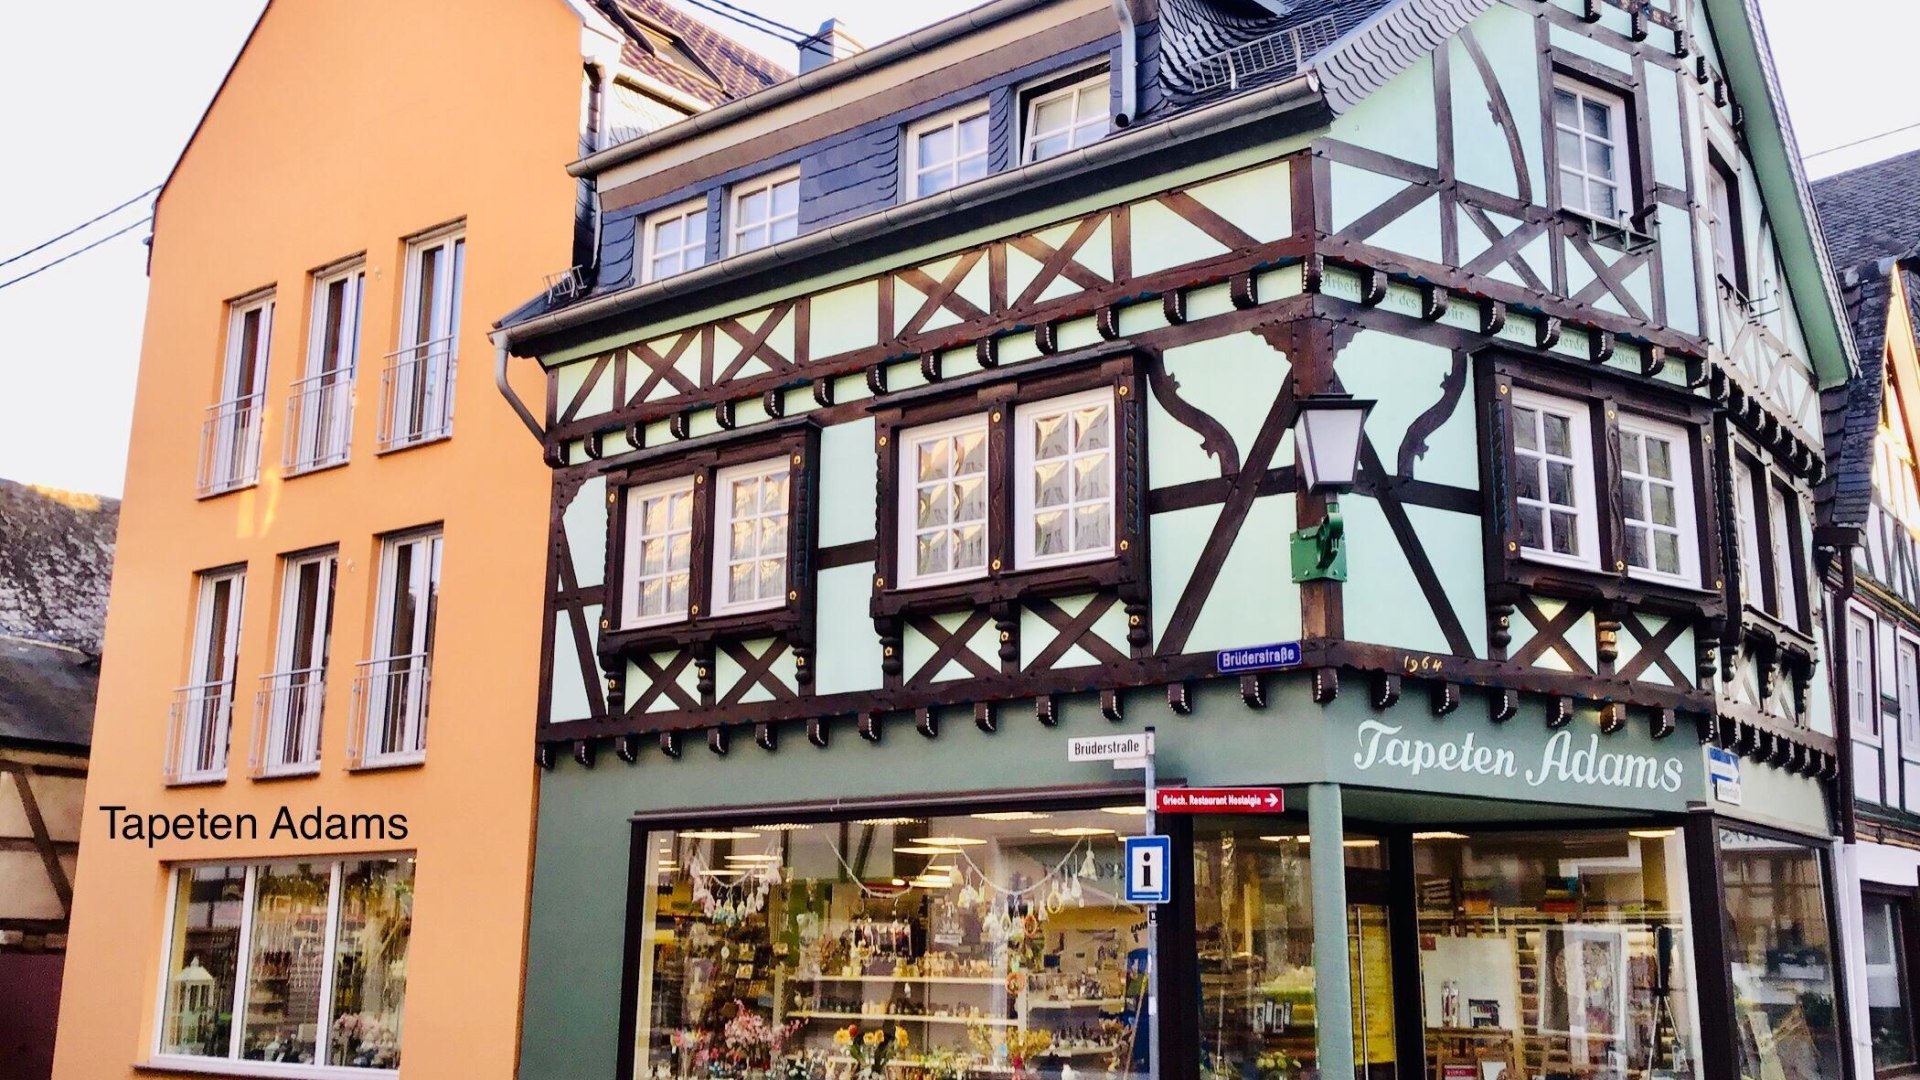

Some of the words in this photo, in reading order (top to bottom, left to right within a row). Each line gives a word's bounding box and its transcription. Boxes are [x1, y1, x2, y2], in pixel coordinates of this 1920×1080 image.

[1399, 294, 1418, 310] des
[1560, 335, 1587, 353] ierde
[1613, 351, 1639, 367] egen
[1222, 647, 1295, 668] Brüderstraße
[1403, 655, 1444, 673] 1964
[1074, 738, 1140, 756] Brüderstraße
[1353, 719, 1517, 778] Tapeten
[1525, 729, 1684, 793] Adams
[1162, 794, 1188, 806] Griech.
[1189, 794, 1228, 806] Restaurant
[1228, 794, 1262, 808] Nostalgia
